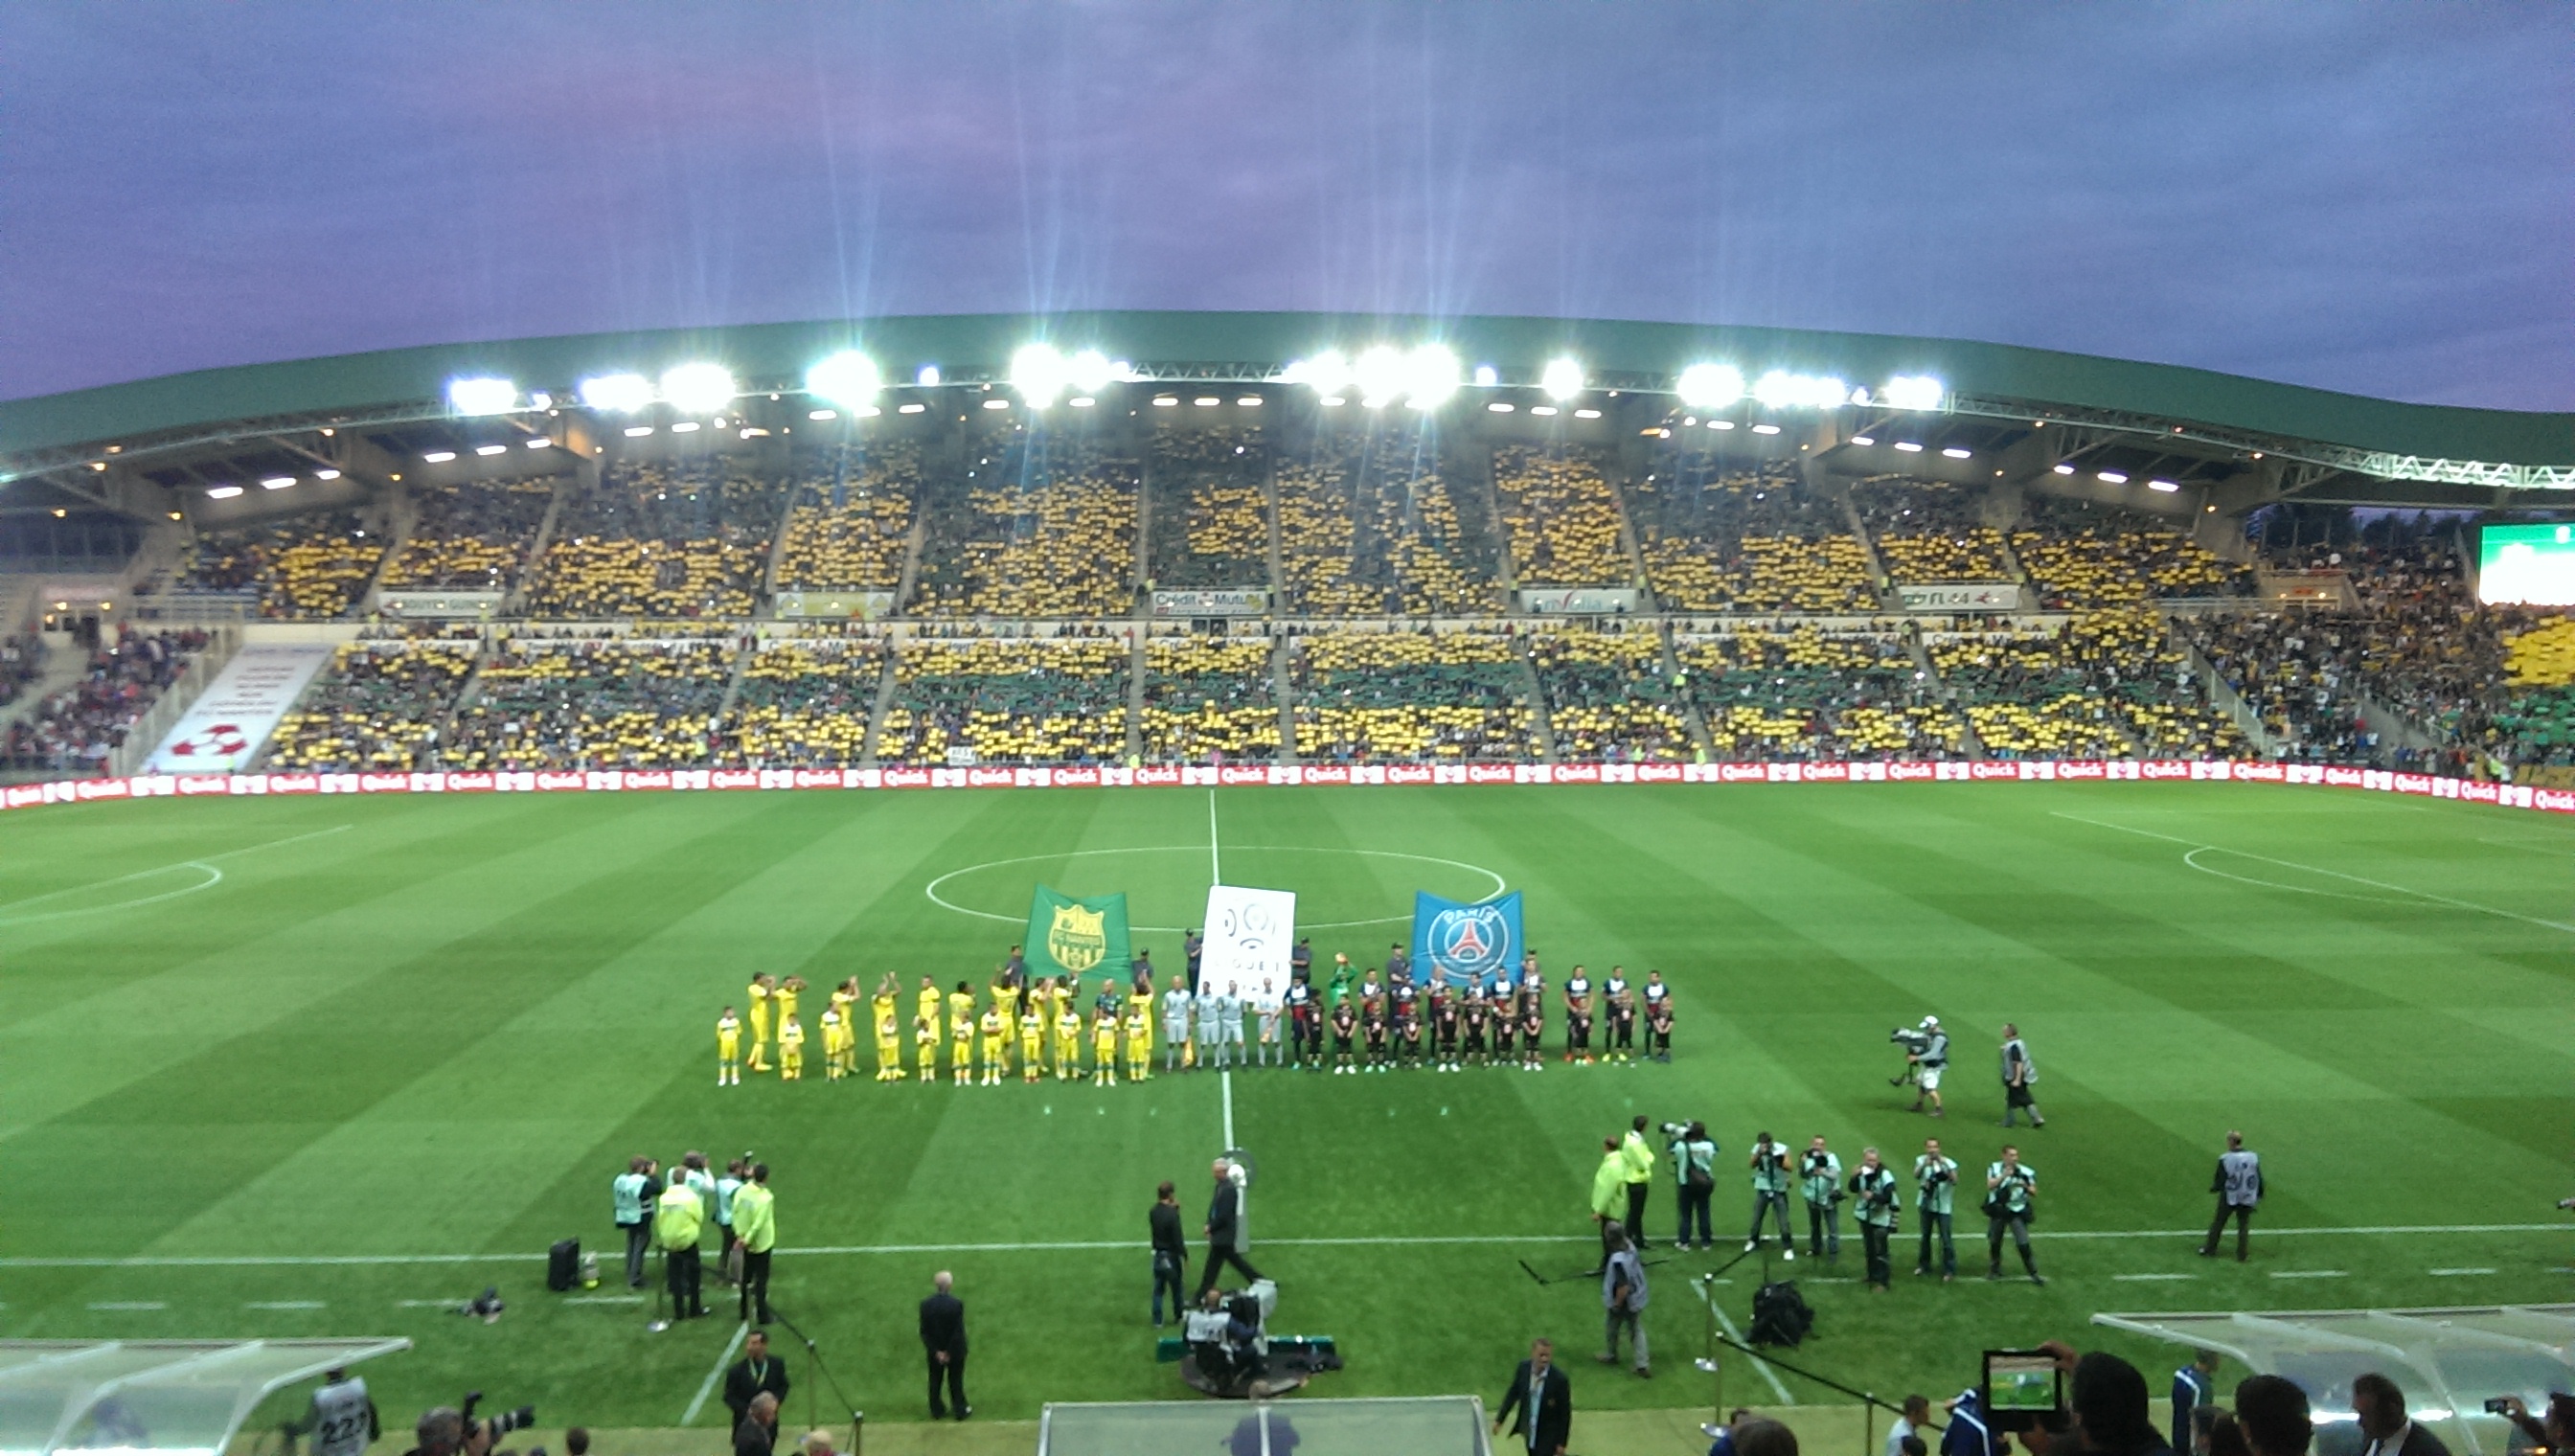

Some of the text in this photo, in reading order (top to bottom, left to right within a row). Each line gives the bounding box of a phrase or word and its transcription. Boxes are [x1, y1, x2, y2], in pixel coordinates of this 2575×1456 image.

[1155, 593, 1259, 605] Crédit Mutu
[884, 770, 927, 785] Quick
[969, 769, 1012, 785] Quick
[1055, 769, 1097, 785] Quick
[1136, 768, 1177, 784] Quick
[1222, 768, 1264, 783] Quick
[1305, 767, 1347, 783] Quick
[1388, 767, 1430, 783] Quick
[1470, 766, 1511, 782] Quick
[1555, 766, 1597, 781] Quick
[1638, 765, 1679, 781] Quick
[1722, 764, 1764, 780] Quick
[1804, 764, 1845, 780] Quick
[1889, 763, 1930, 779] Quick
[1973, 763, 2015, 778] Quick
[2059, 763, 2102, 778] Quick
[2144, 762, 2186, 778] Quick
[2234, 763, 2282, 779] Quick
[2326, 768, 2360, 784] Quick
[448, 774, 491, 789] Quick
[537, 773, 582, 789] Quick
[626, 773, 669, 788] Quick
[713, 771, 758, 787] Quick
[796, 771, 839, 786] Quick
[2395, 775, 2429, 791] Quick
[2461, 782, 2495, 799] Quick
[1443, 906, 1495, 924] PARIS
[1214, 958, 1265, 971] LGUE
